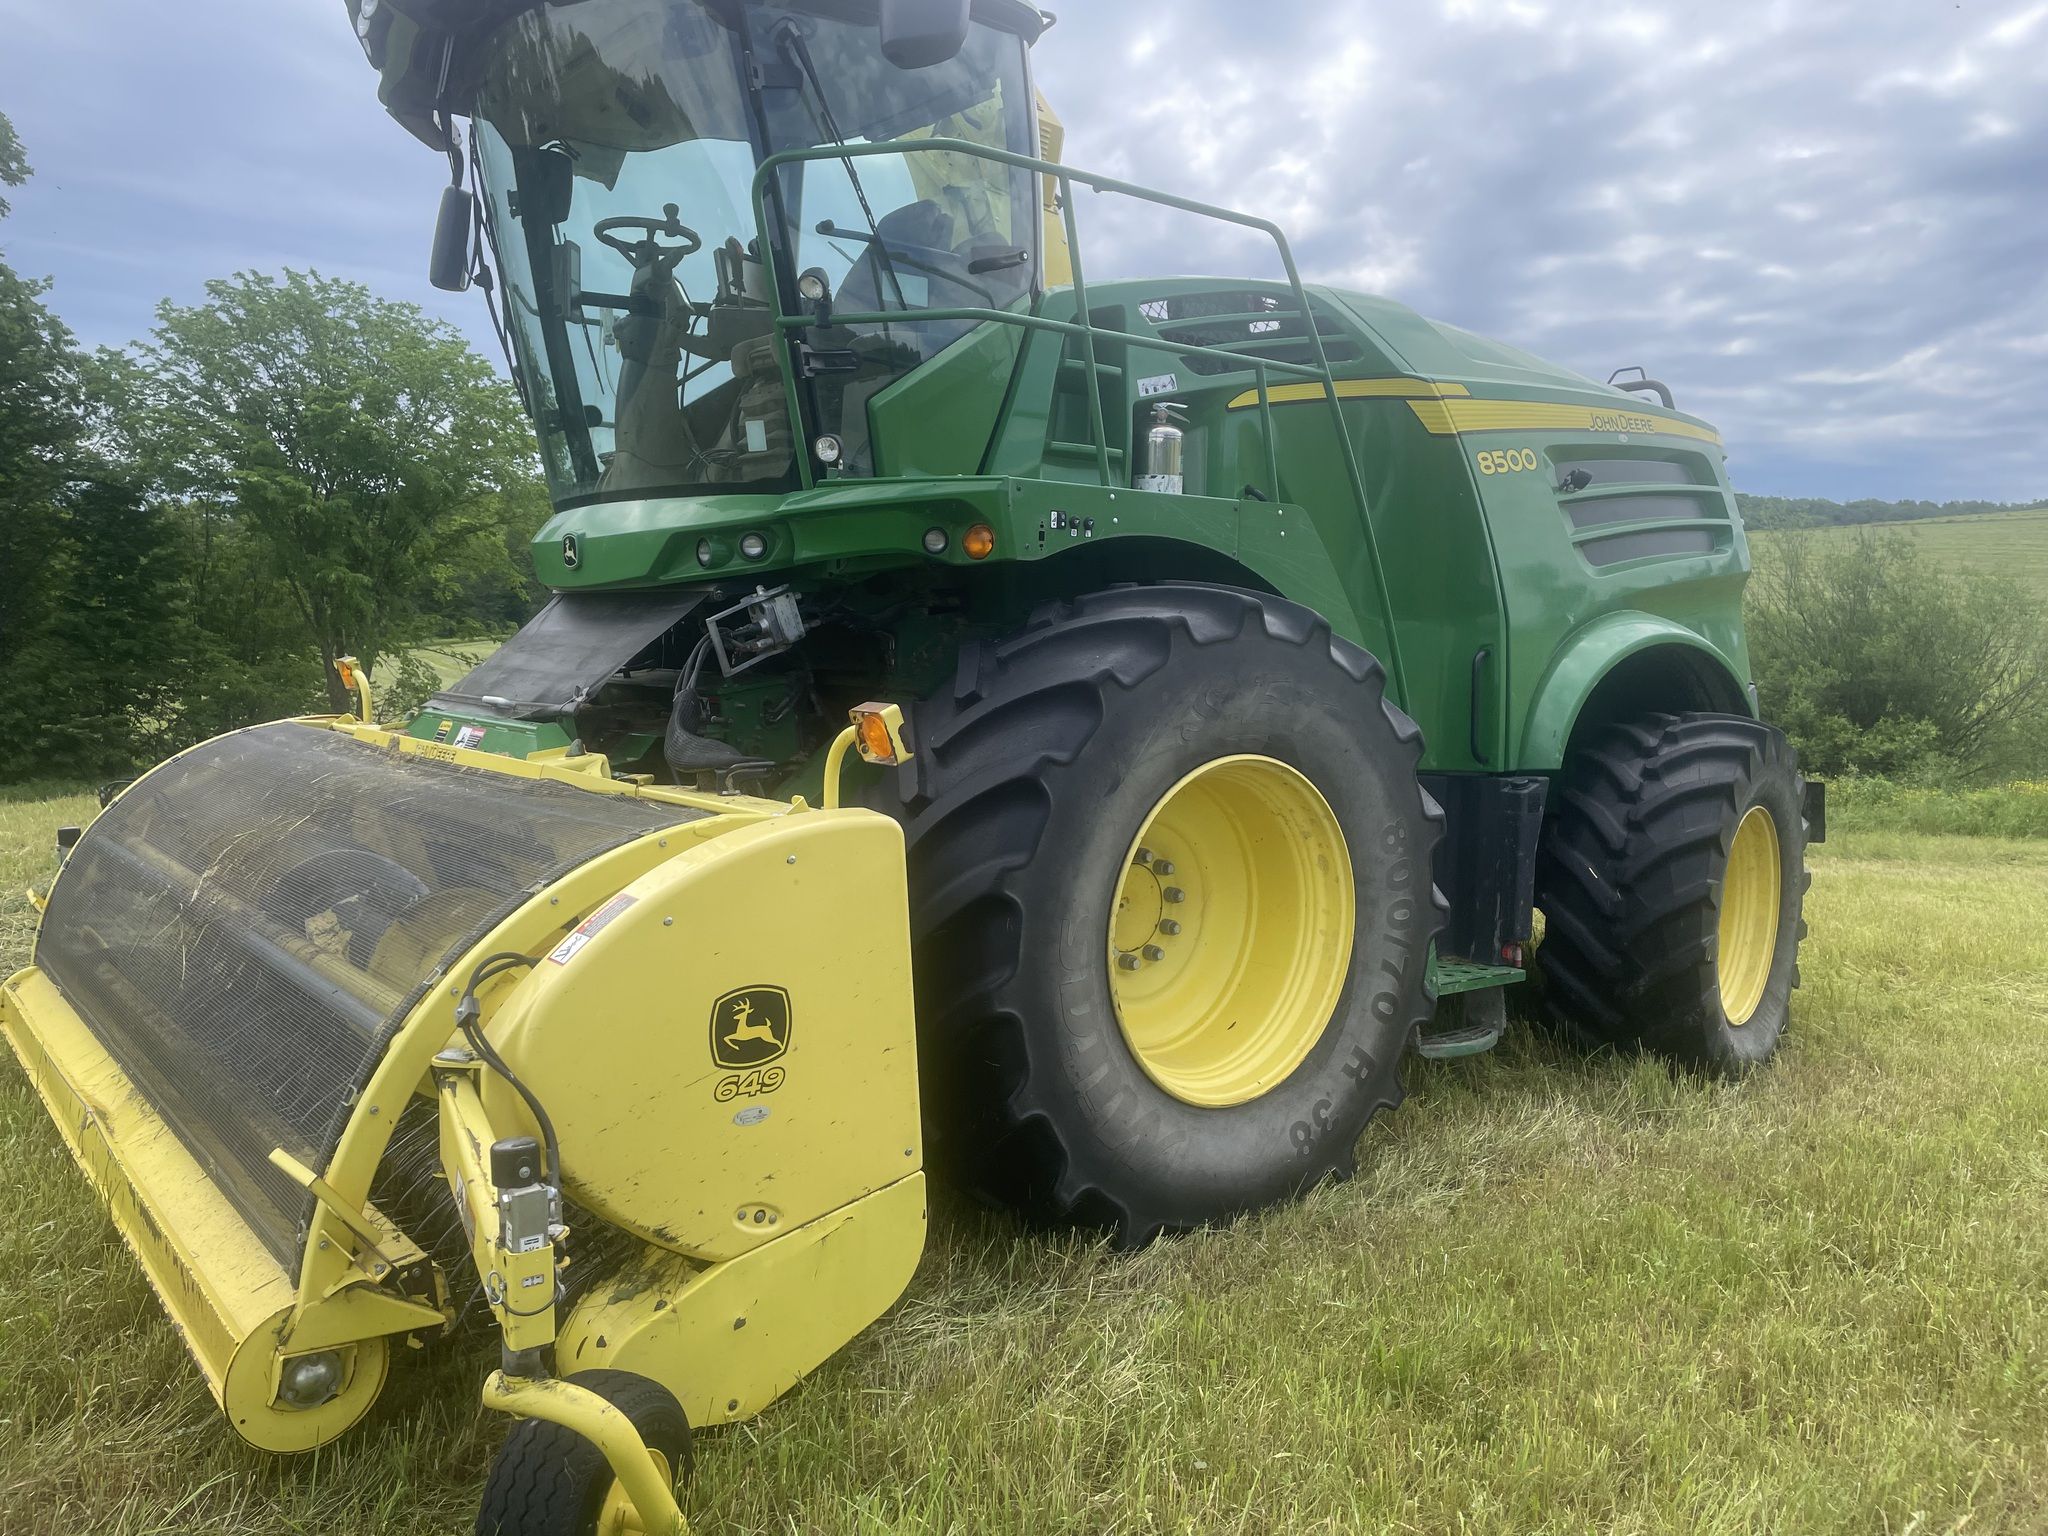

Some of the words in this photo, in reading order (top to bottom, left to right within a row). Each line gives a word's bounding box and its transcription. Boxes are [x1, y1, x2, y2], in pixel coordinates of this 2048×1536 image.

[1589, 412, 1618, 431] JOHN
[1617, 414, 1655, 434] DEERE
[1476, 447, 1538, 475] 8500
[1371, 817, 1419, 1025] 800/70
[713, 1066, 786, 1102] 649
[1341, 1043, 1378, 1092] R
[1289, 1098, 1341, 1163] 38
